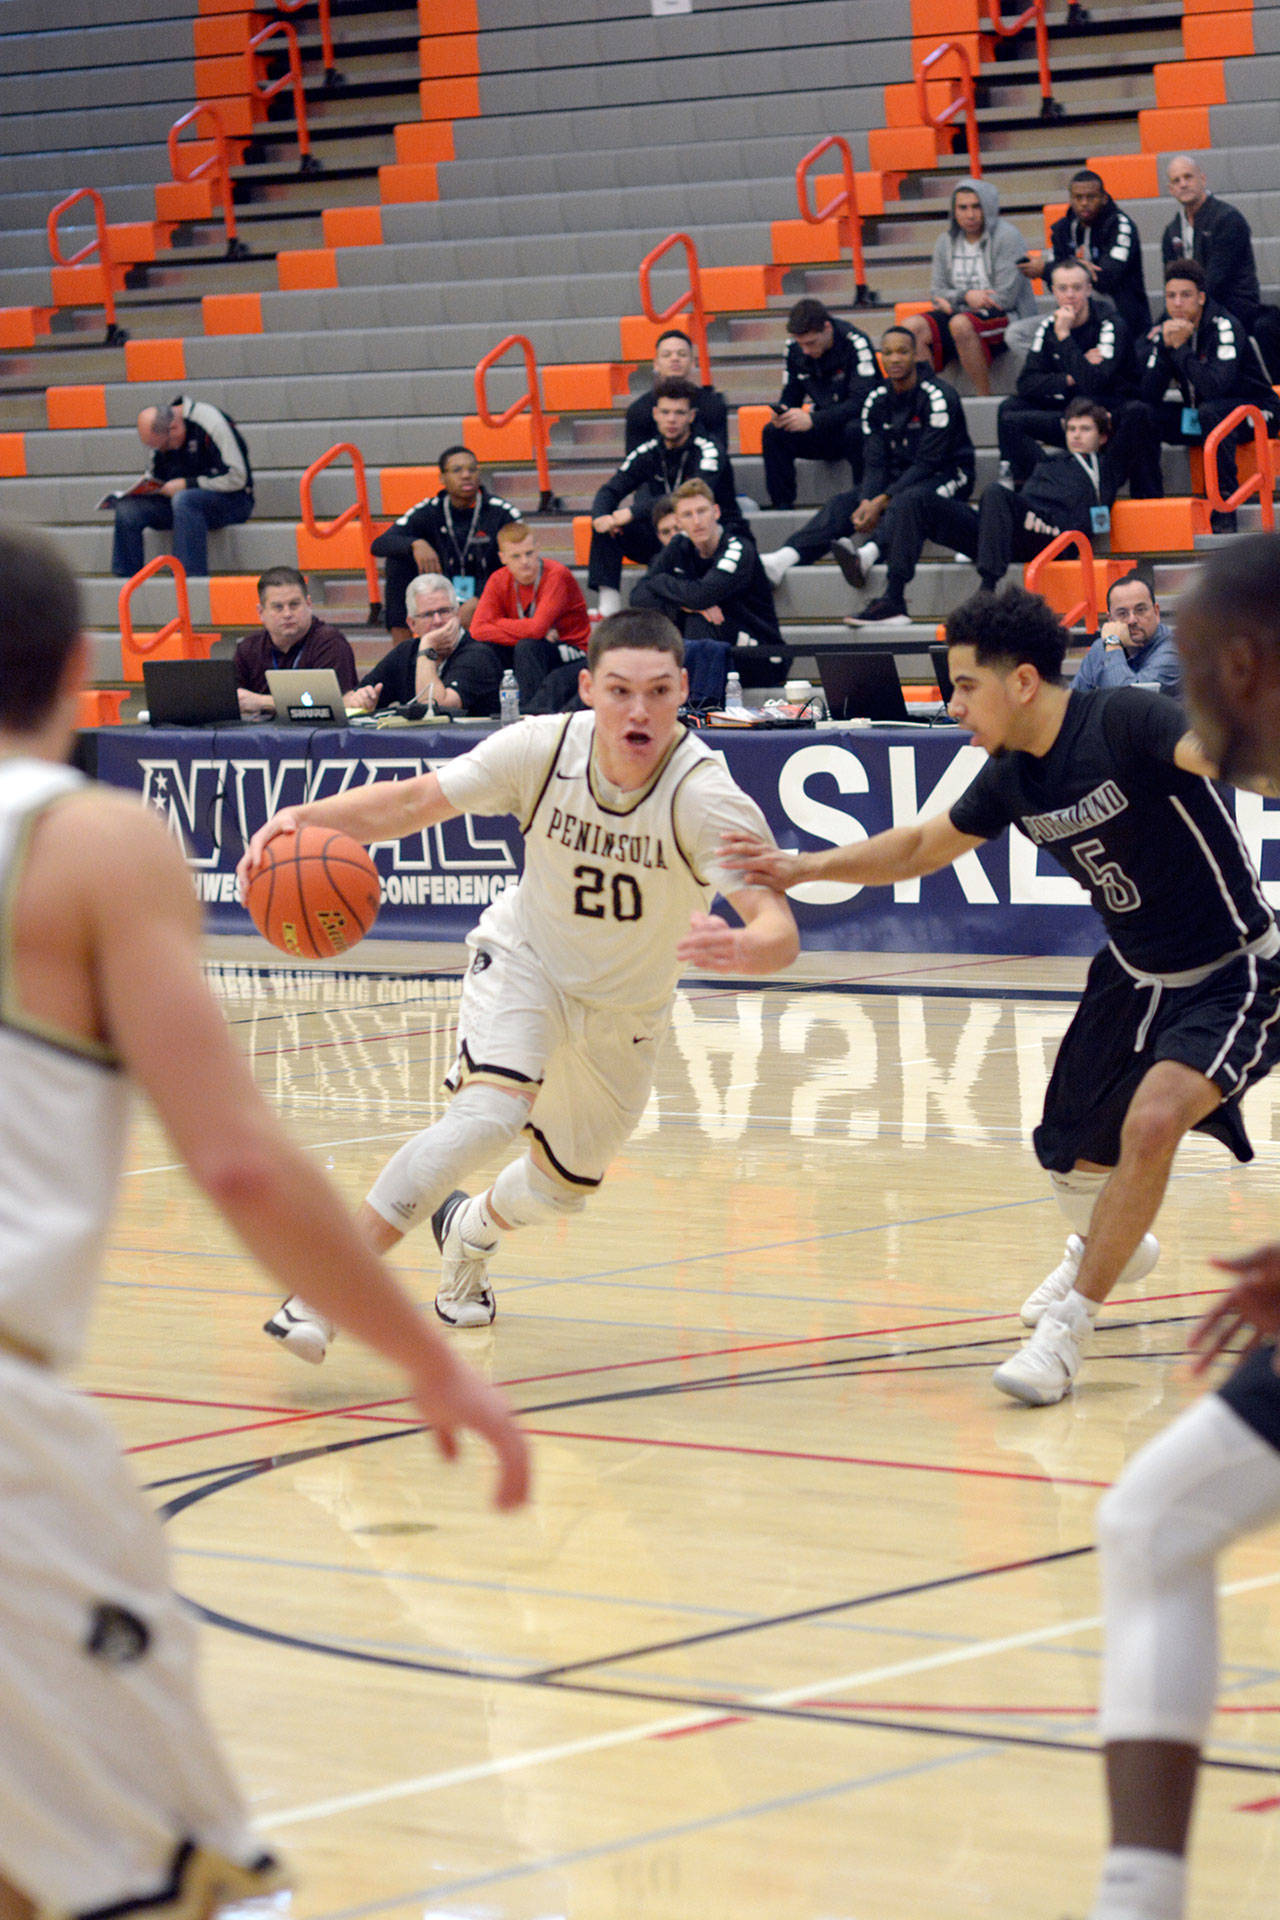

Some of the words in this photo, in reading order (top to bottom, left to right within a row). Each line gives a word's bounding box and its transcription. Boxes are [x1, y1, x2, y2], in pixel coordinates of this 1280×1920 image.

[289, 707, 330, 719] SHURE
[546, 807, 669, 870] PENINSULA
[1020, 779, 1129, 845] PORTLAND
[573, 864, 642, 922] 20
[1070, 838, 1142, 913] 5
